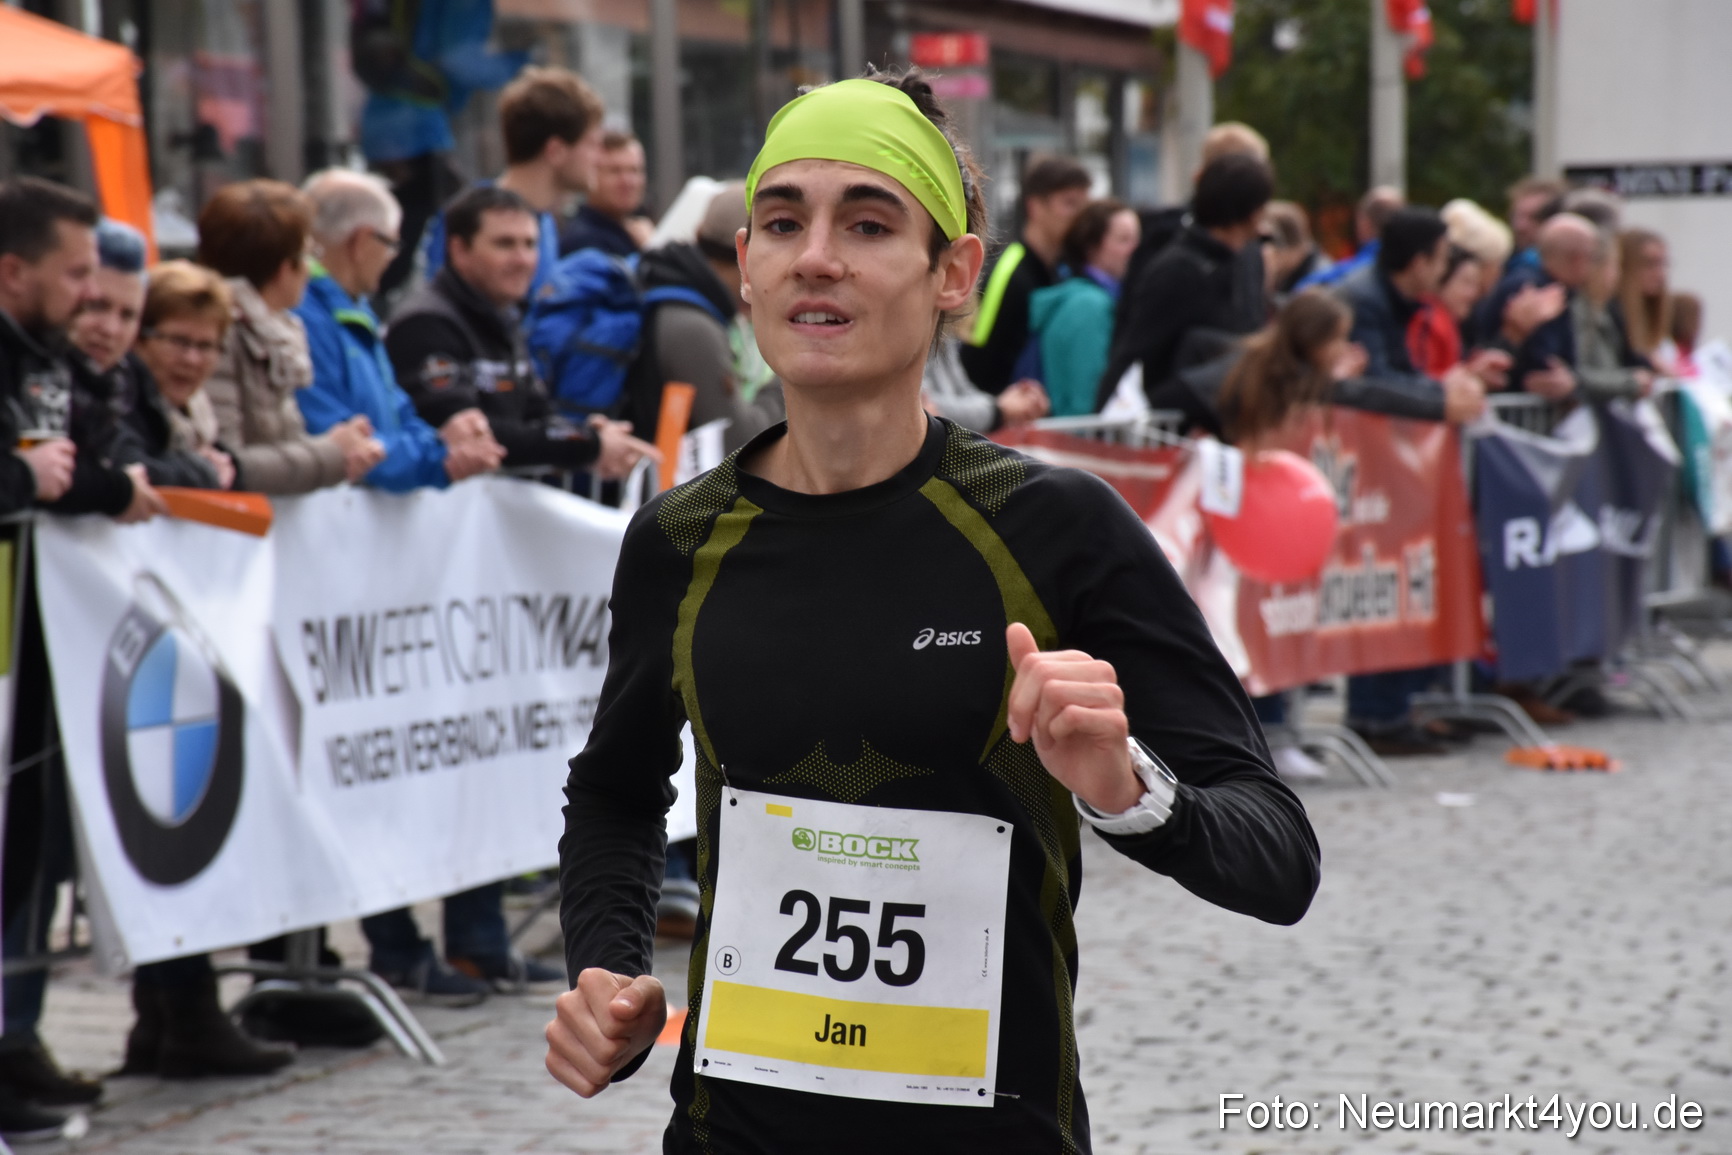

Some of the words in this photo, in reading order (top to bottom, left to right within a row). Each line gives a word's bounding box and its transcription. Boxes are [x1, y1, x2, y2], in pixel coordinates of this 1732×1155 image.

[818, 830, 920, 862] BOCK
[817, 854, 846, 866] inspired
[848, 859, 857, 867] by
[859, 860, 883, 869] smart
[884, 863, 920, 872] concepts
[774, 889, 926, 987] 255
[723, 953, 733, 969] B
[814, 1013, 867, 1047] Jan
